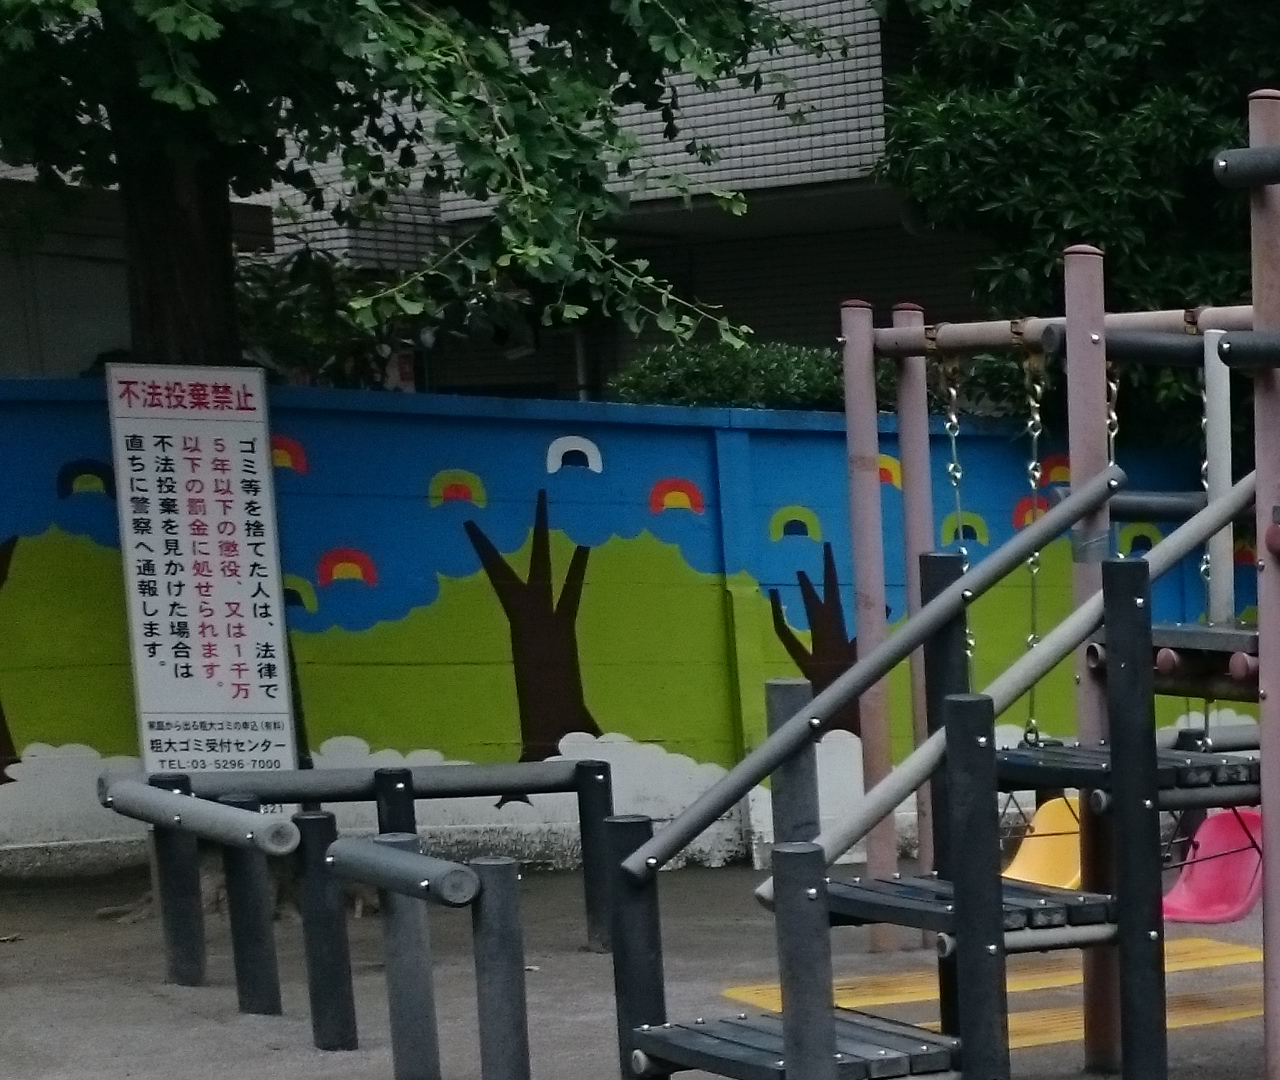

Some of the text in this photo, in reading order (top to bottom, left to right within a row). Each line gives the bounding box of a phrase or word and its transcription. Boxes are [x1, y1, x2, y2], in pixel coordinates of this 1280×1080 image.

[118, 380, 257, 413] 不法投棄禁止
[124, 434, 166, 667] 直ちに警察へ通報します。
[153, 435, 194, 679] 不法投棄を見かけた場合は
[182, 436, 225, 687] 以下の罰金に処せられます。
[239, 437, 279, 699] ゴミ等を捨てた人は、法律で
[150, 738, 286, 753] 粗大ゴミ受付センター
